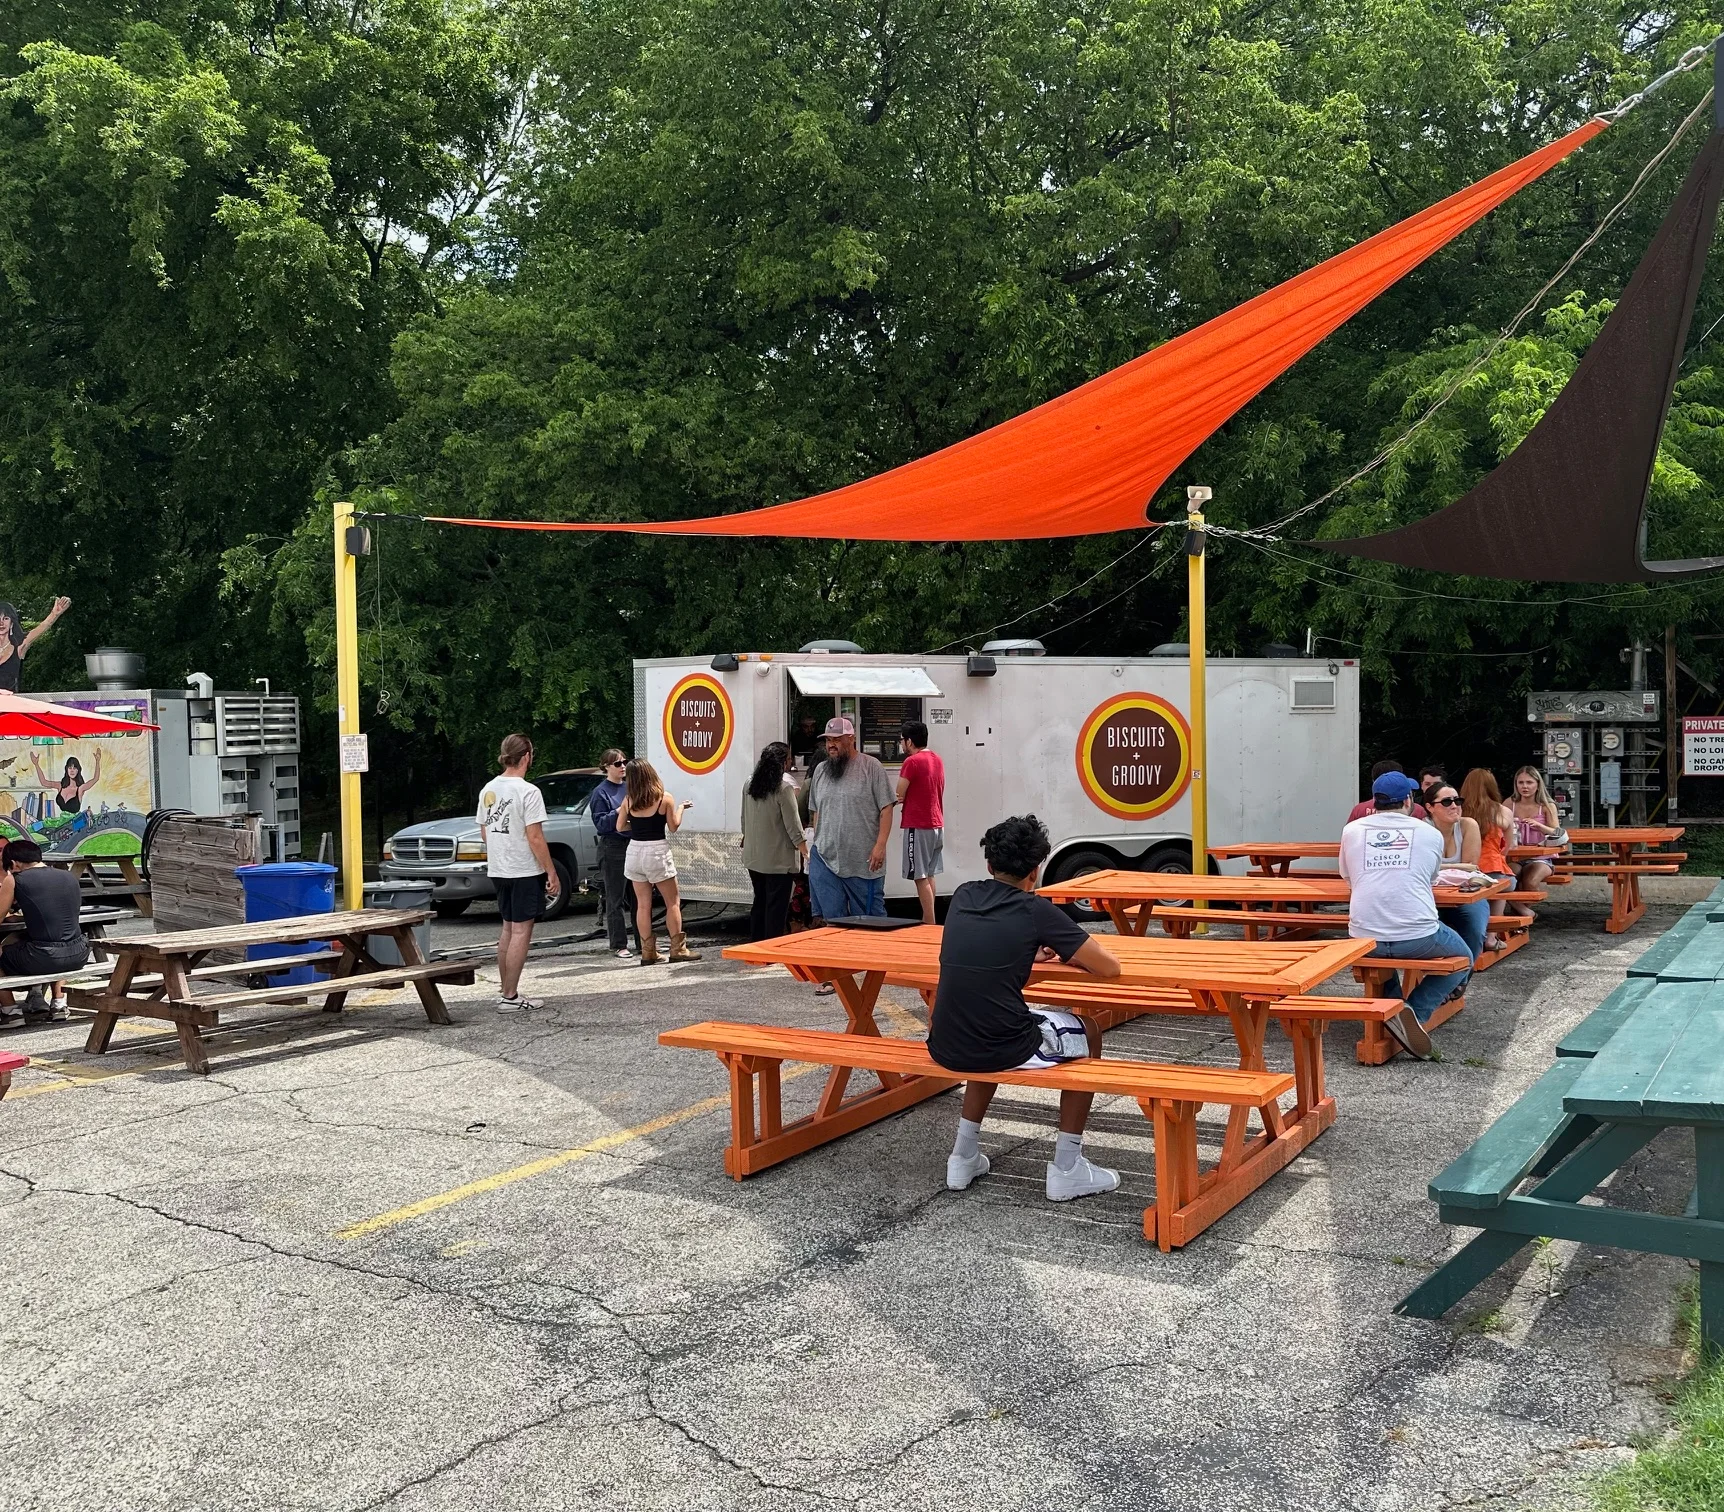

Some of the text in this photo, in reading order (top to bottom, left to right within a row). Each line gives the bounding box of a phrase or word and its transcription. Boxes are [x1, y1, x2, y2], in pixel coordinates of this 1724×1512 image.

[680, 700, 716, 718] BISCUITS
[1685, 720, 1724, 730] PRIVATE
[682, 730, 713, 748] GROOVY
[1107, 726, 1165, 748] BISCUITS
[1112, 765, 1162, 786] GROOVY
[1373, 853, 1401, 861] cisco
